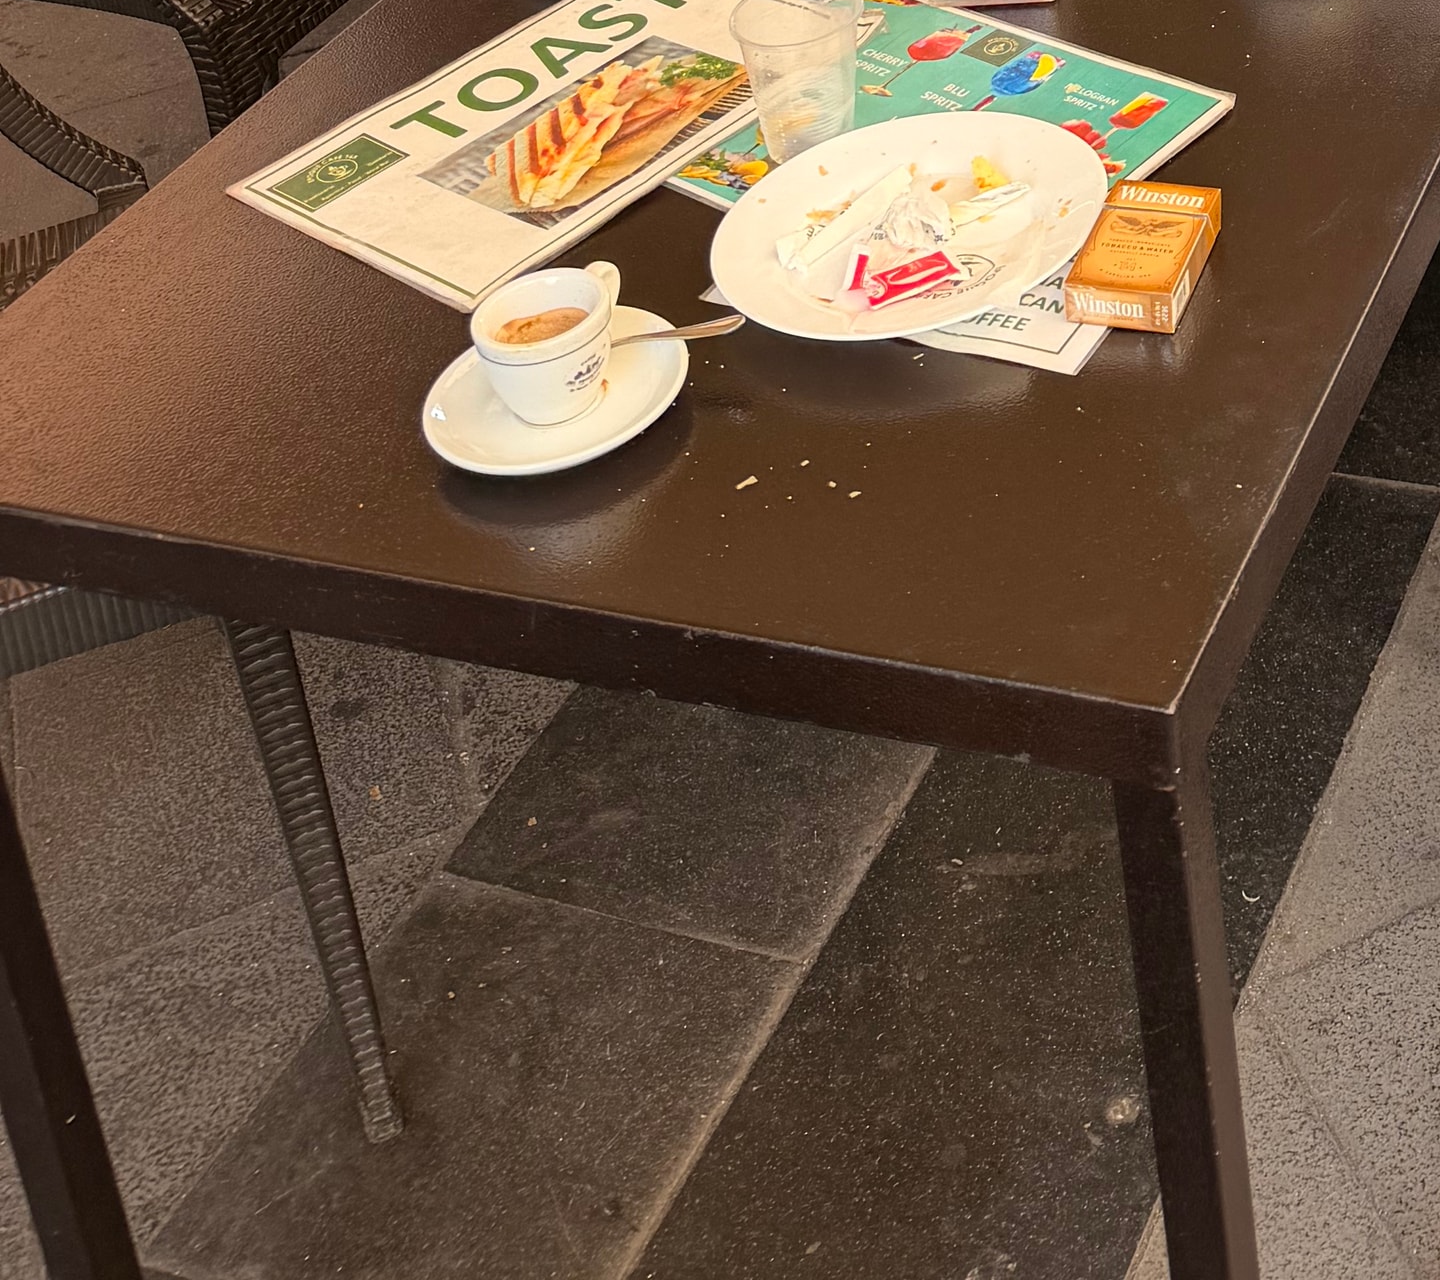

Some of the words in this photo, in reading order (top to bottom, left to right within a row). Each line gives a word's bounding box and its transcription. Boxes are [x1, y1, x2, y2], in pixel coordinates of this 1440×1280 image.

[854, 59, 891, 77] SPRITZ
[861, 48, 907, 68] CHERRY
[943, 83, 971, 98] BLU
[919, 91, 964, 112] SPRITZ
[1062, 94, 1098, 110] SPRITZ
[1120, 185, 1205, 209] Winston
[1073, 292, 1144, 319] Winston
